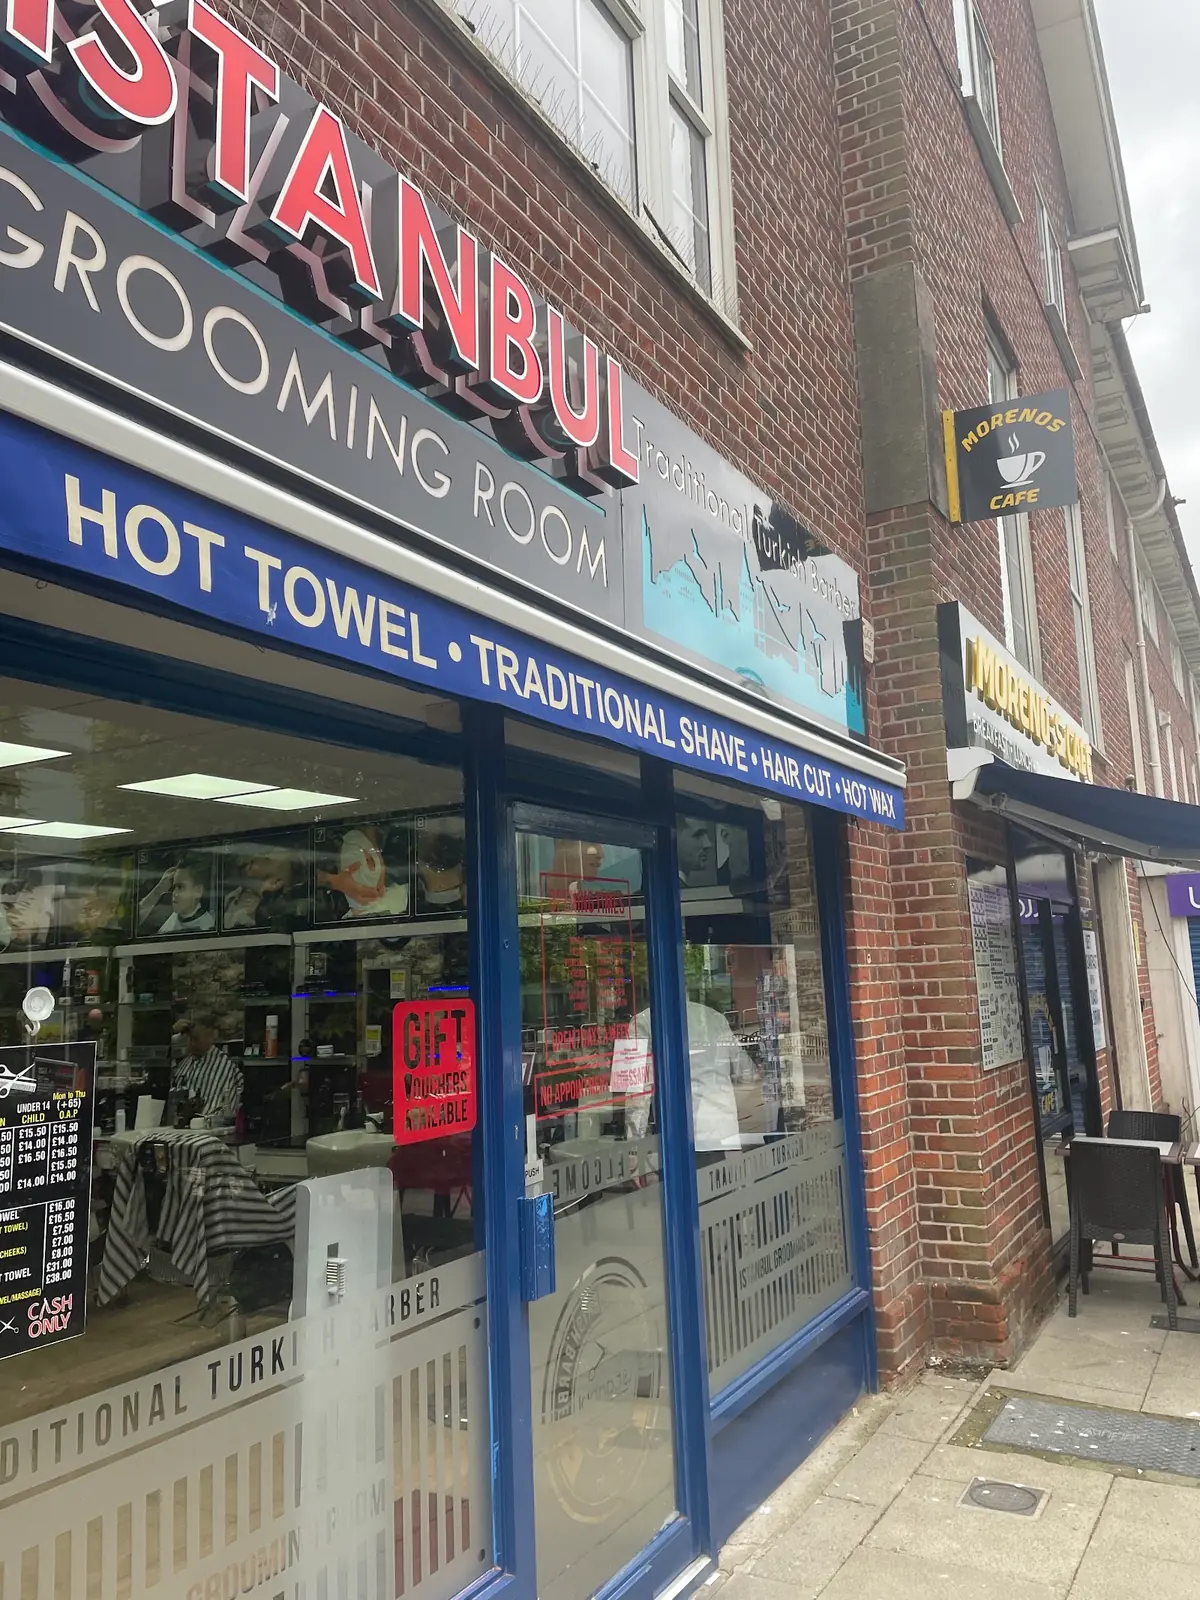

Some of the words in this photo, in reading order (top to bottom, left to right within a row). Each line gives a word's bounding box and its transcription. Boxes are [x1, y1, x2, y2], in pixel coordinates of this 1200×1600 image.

[961, 407, 1067, 453] MORENOS
[989, 488, 1040, 510] CAFE
[631, 414, 750, 541] Traditional
[753, 514, 806, 584] Turkish
[811, 559, 856, 619] Barber
[473, 460, 609, 588] ROOM
[64, 473, 226, 593] HOT
[244, 546, 438, 670] TOWEL
[470, 635, 676, 749] TRADITIONAL
[678, 716, 749, 773] SHAVE
[760, 746, 802, 790] HAIR
[803, 763, 832, 799] CUT
[841, 777, 869, 811] HOT
[868, 786, 896, 820] WAX
[403, 1009, 466, 1070] GIFT
[552, 1030, 574, 1053] OPEN
[404, 1071, 468, 1101] VOUCHERS
[52, 1092, 67, 1101] Mon
[75, 1090, 86, 1098] Thu
[540, 1082, 553, 1107] NO
[17, 1101, 41, 1114] UNDER
[42, 1100, 51, 1111] 14
[56, 1098, 82, 1111] (+65)
[21, 1112, 45, 1125] CHILD
[59, 1109, 79, 1120] O.A.P
[404, 1099, 468, 1132] AVAILABLE
[19, 1125, 47, 1139] £15.50
[52, 1121, 79, 1135] £15.50
[18, 1138, 46, 1152] £14.00
[51, 1134, 78, 1147] £14.00
[17, 1150, 46, 1164] £16.50
[50, 1158, 77, 1172] £15.50
[17, 1175, 45, 1190] £14.00
[50, 1170, 77, 1184] £14.00
[48, 1211, 75, 1225] £16.50
[4, 1222, 29, 1234] TOWEL)
[52, 1222, 74, 1236] £7.50
[52, 1234, 74, 1248] £7.00
[51, 1246, 73, 1259] £8.00
[46, 1257, 73, 1273] £31.00
[4, 1267, 32, 1282] TOWEL
[45, 1269, 72, 1285] £38.00
[27, 1293, 73, 1321] CASH
[28, 1311, 72, 1339] ONLY
[207, 1316, 335, 1400] TURKIH
